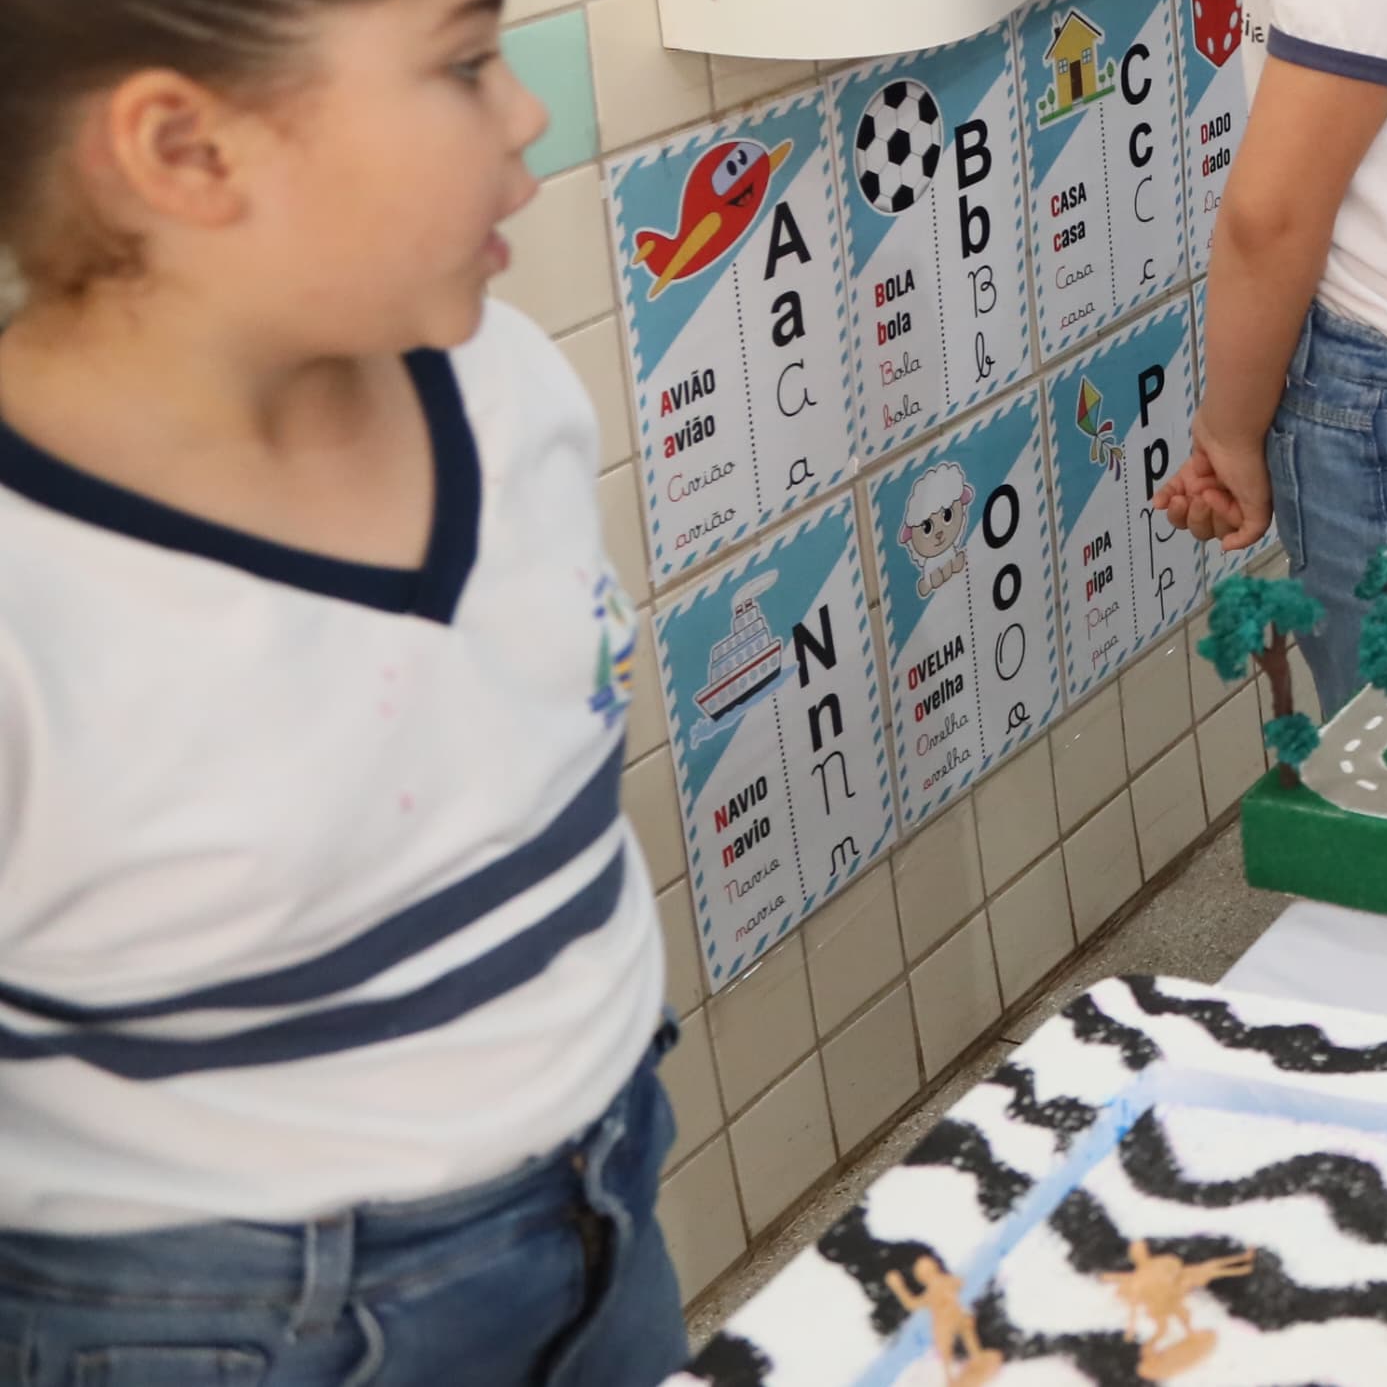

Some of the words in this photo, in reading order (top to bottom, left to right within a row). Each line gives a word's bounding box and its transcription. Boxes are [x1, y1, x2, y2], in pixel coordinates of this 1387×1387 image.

[1120, 43, 1152, 106] C
[1200, 111, 1232, 145] DADO
[954, 117, 992, 191] B
[1202, 147, 1231, 177] dado
[1050, 181, 1088, 218] CASA
[763, 200, 812, 281] A
[958, 194, 991, 259] b
[1053, 220, 1087, 253] casa
[874, 269, 916, 309] BOLA
[967, 264, 998, 318] B
[1055, 260, 1095, 290] Casa
[769, 290, 806, 348] a
[876, 310, 912, 346] bola
[660, 367, 716, 418] AVIÃO
[879, 350, 923, 388] Bola
[882, 393, 923, 431] bola
[1137, 363, 1166, 429] P
[662, 413, 716, 460] avião
[1143, 437, 1170, 502] p
[674, 507, 737, 551] avião
[981, 483, 1021, 550] O
[1082, 529, 1112, 567] PIPA
[1084, 564, 1114, 602] pipa
[791, 604, 837, 690] N
[907, 633, 965, 692] OVELHA
[806, 691, 845, 754] n
[913, 671, 964, 723] ovelha
[915, 710, 969, 757] Ovelha
[713, 774, 769, 834] NAVIO
[721, 814, 771, 869] navio
